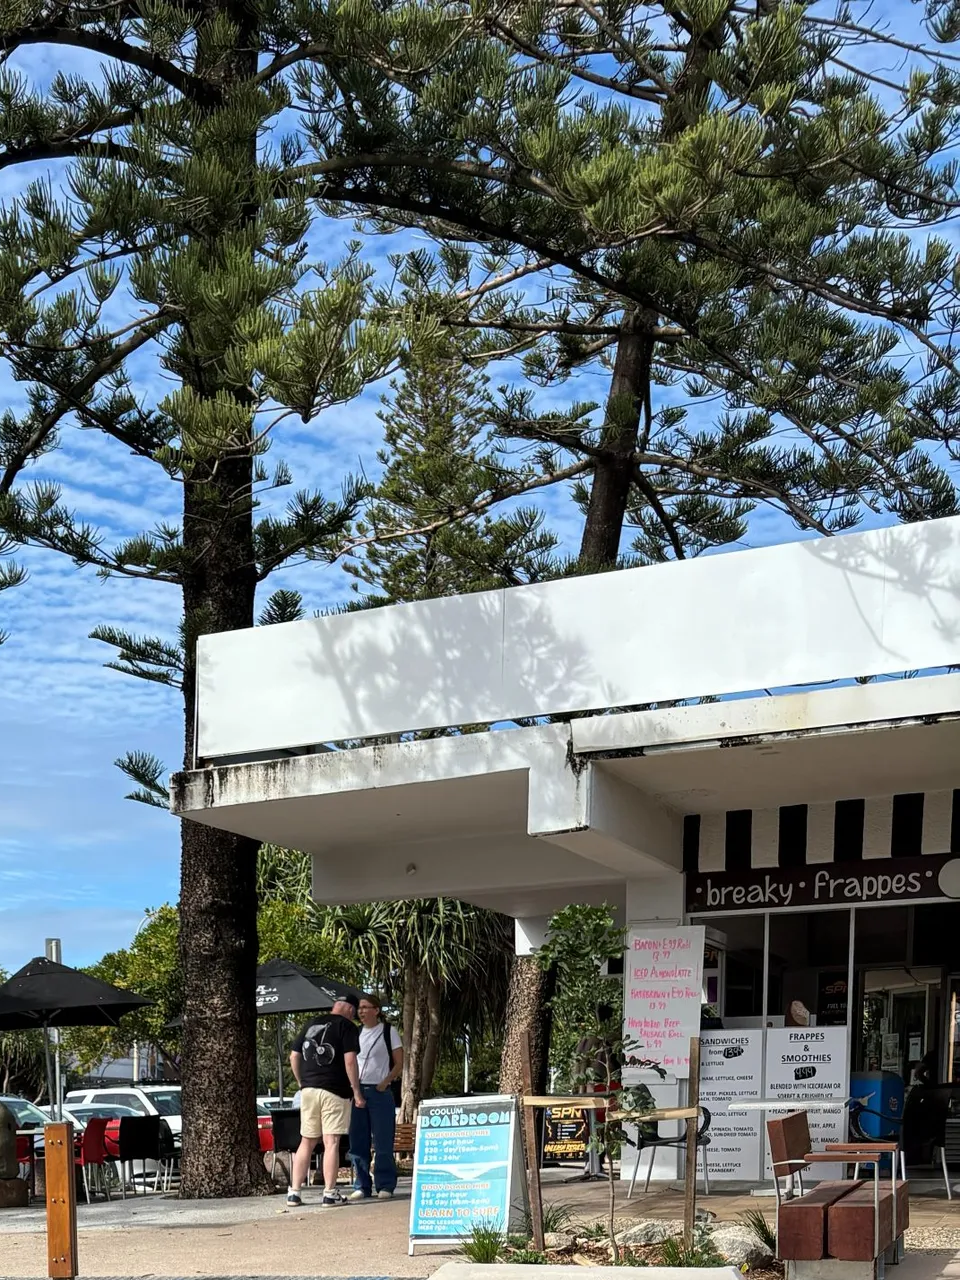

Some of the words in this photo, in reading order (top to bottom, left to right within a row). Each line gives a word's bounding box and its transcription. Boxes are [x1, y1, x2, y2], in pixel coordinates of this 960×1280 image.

[706, 875, 793, 906] breaky
[814, 870, 921, 900] frappes
[789, 1032, 825, 1041] FRAPPES
[700, 1037, 750, 1046] SANDWICHES
[803, 1044, 810, 1052] &
[781, 1054, 832, 1062] SMOOTHIES
[430, 1108, 463, 1116] COOLUM
[421, 1111, 510, 1128] BOARDROOM
[419, 1208, 453, 1217] LEARN
[456, 1208, 470, 1216] TO
[473, 1207, 499, 1216] SURF
